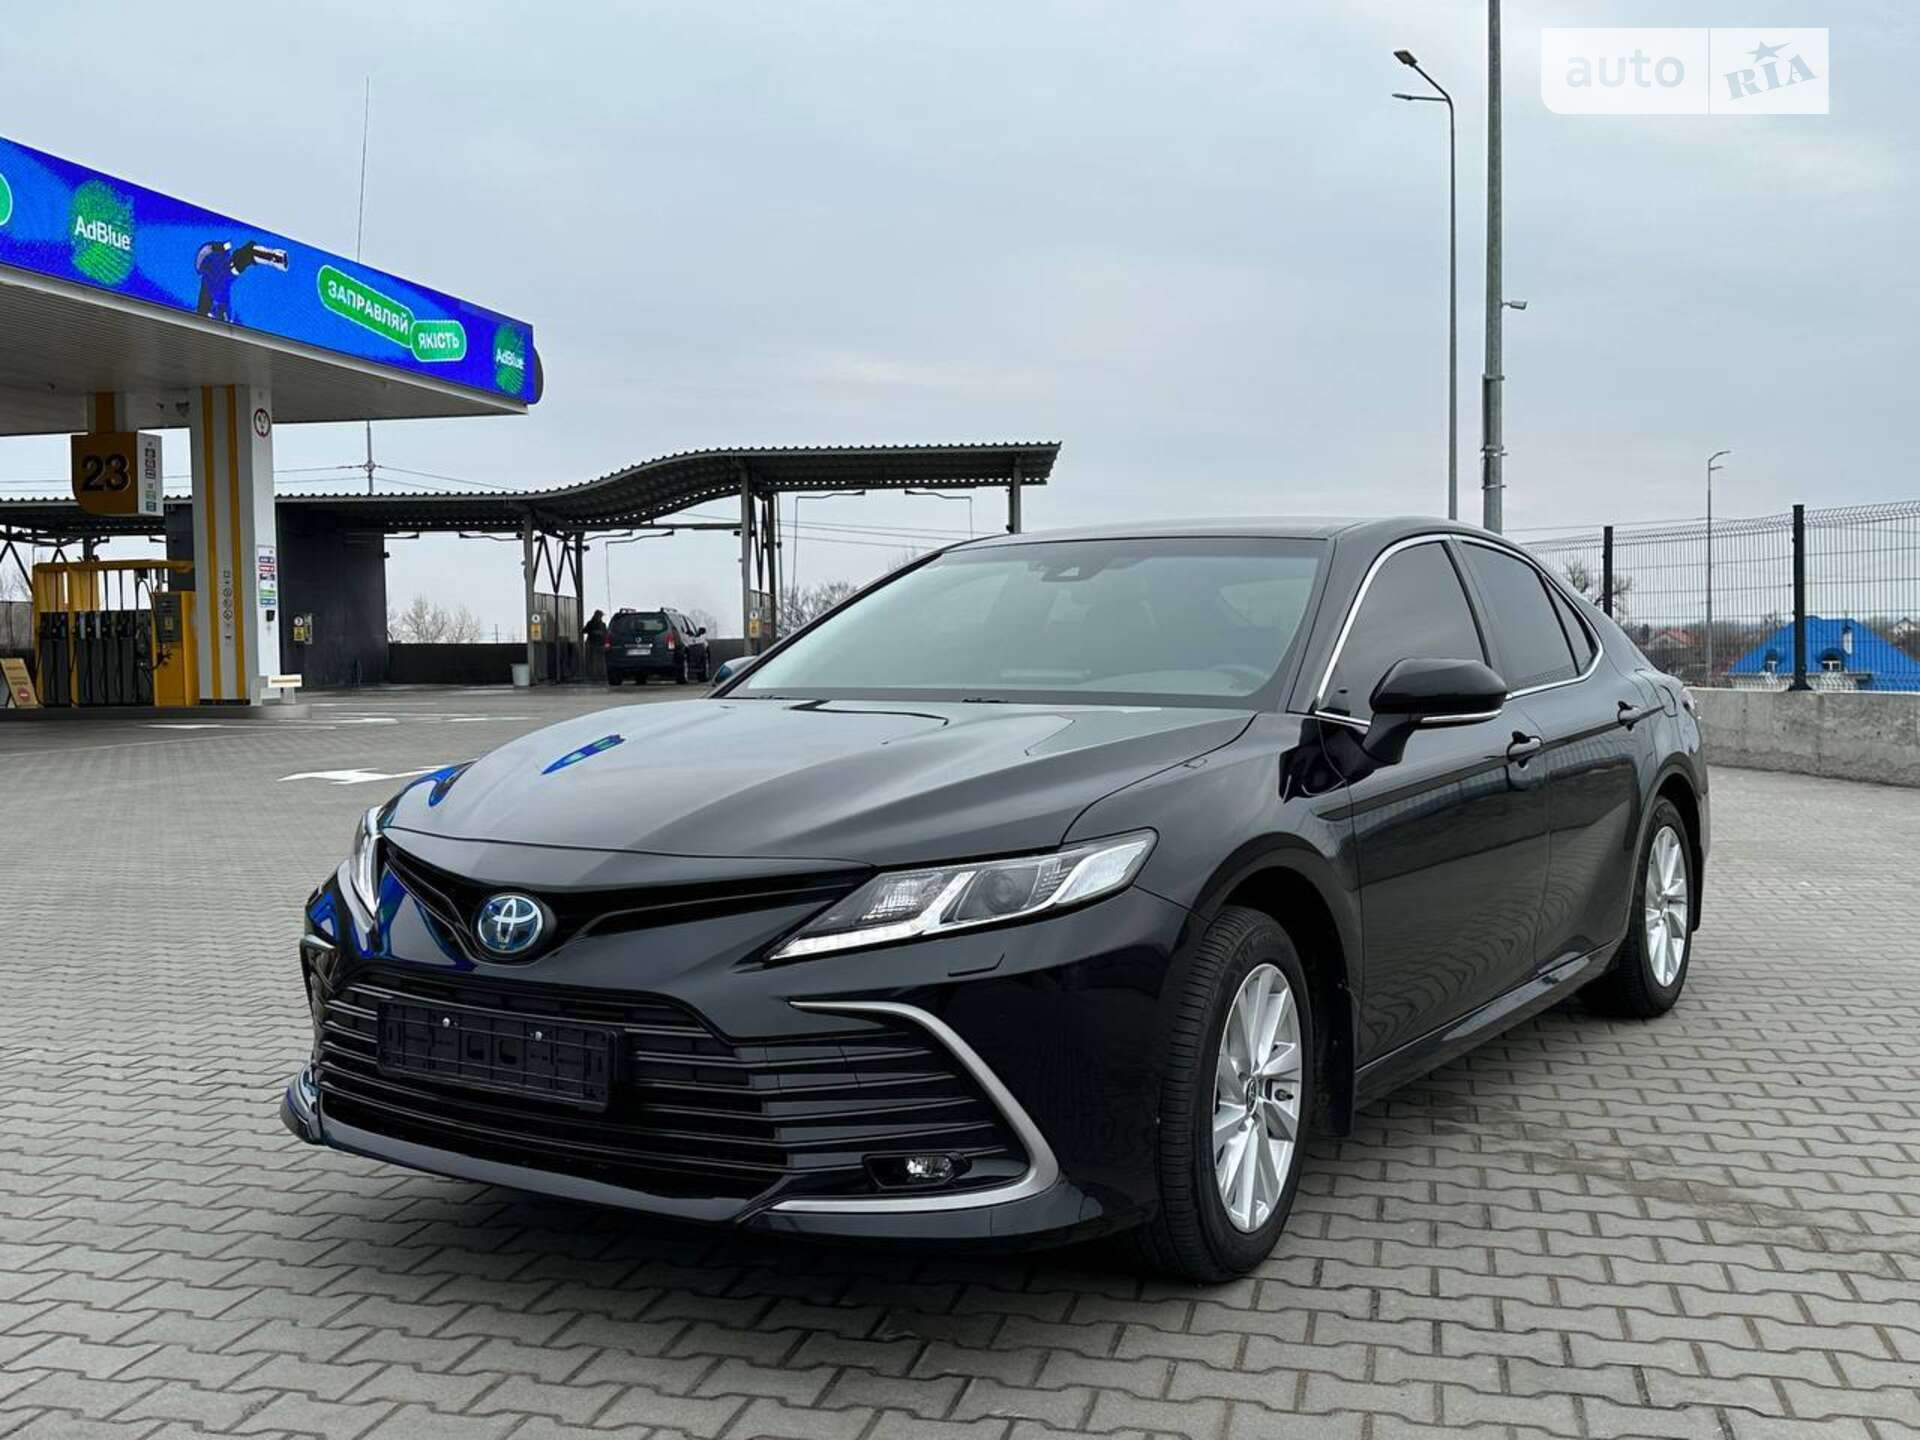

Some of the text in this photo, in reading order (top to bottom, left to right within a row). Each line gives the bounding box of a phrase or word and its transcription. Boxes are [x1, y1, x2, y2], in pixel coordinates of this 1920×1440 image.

[74, 215, 132, 251] AdBlue
[327, 280, 410, 335] ЗАПРАВЛЯЙ
[418, 330, 460, 352] ЯКІСТЬ
[495, 348, 525, 371] AdBlue
[81, 453, 130, 492] 23
